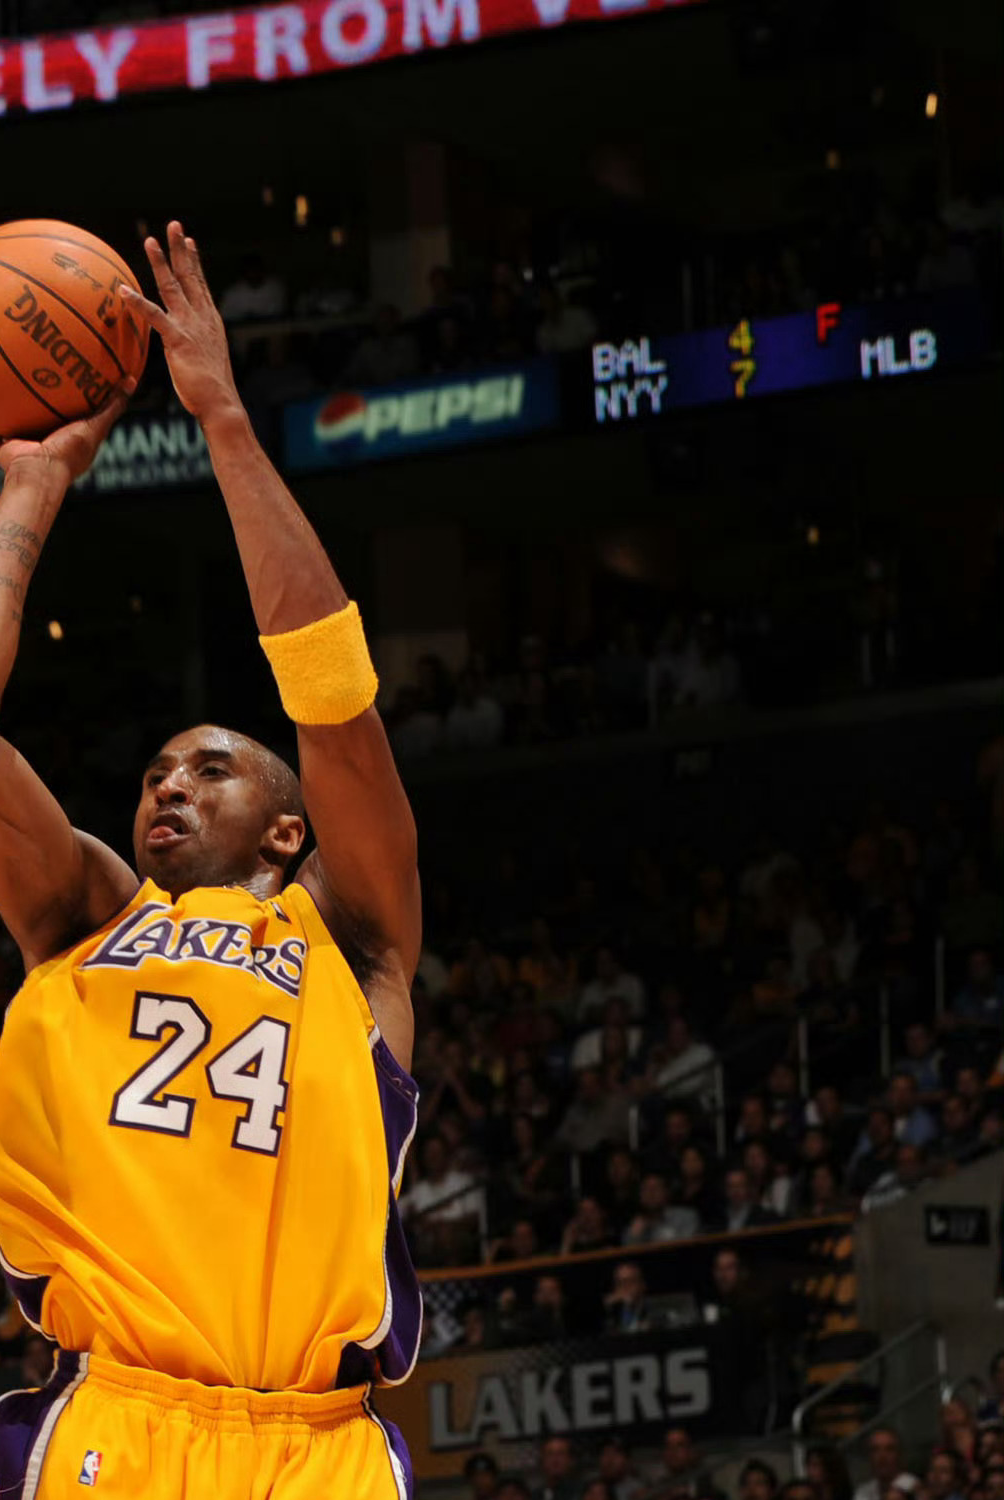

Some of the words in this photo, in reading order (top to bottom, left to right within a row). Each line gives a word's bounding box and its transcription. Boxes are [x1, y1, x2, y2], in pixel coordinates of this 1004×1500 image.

[186, 0, 480, 90] FROM
[592, 335, 667, 382] BAL
[728, 318, 754, 355] 4
[816, 302, 841, 343] F
[860, 329, 938, 380] MLB
[362, 373, 525, 443] PEPSI
[596, 374, 668, 423] NYY
[730, 359, 756, 399] 7
[98, 418, 212, 466] MANU
[78, 900, 307, 999] LAKERS
[108, 990, 290, 1158] 24
[429, 1348, 712, 1447] LAKERS
